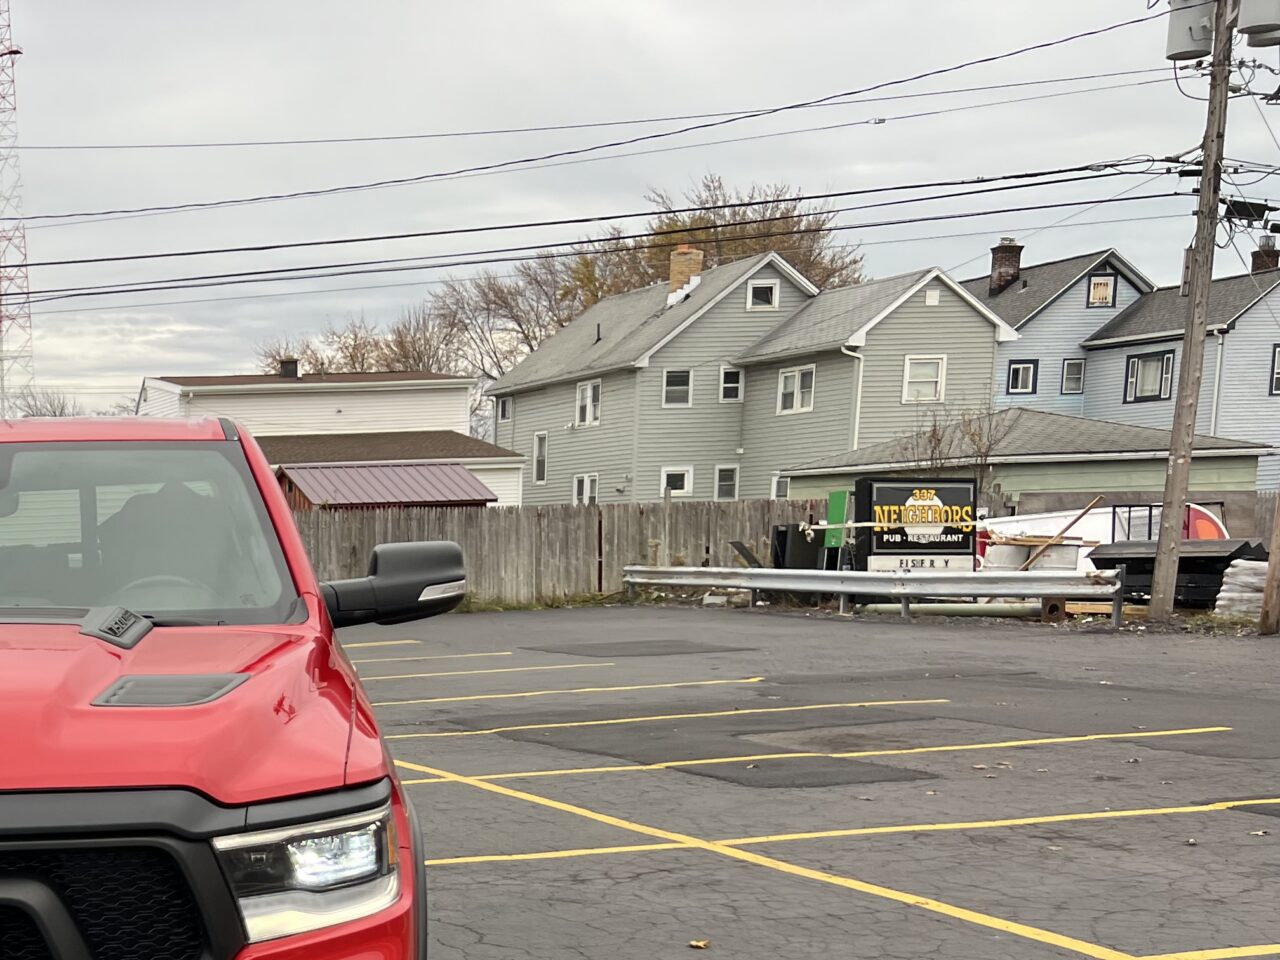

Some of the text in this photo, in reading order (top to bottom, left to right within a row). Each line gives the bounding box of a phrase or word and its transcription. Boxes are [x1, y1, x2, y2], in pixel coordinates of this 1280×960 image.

[912, 489, 936, 500] 337
[873, 505, 973, 532] NEIGHBORS
[883, 534, 963, 543] PUB RESTAURANT
